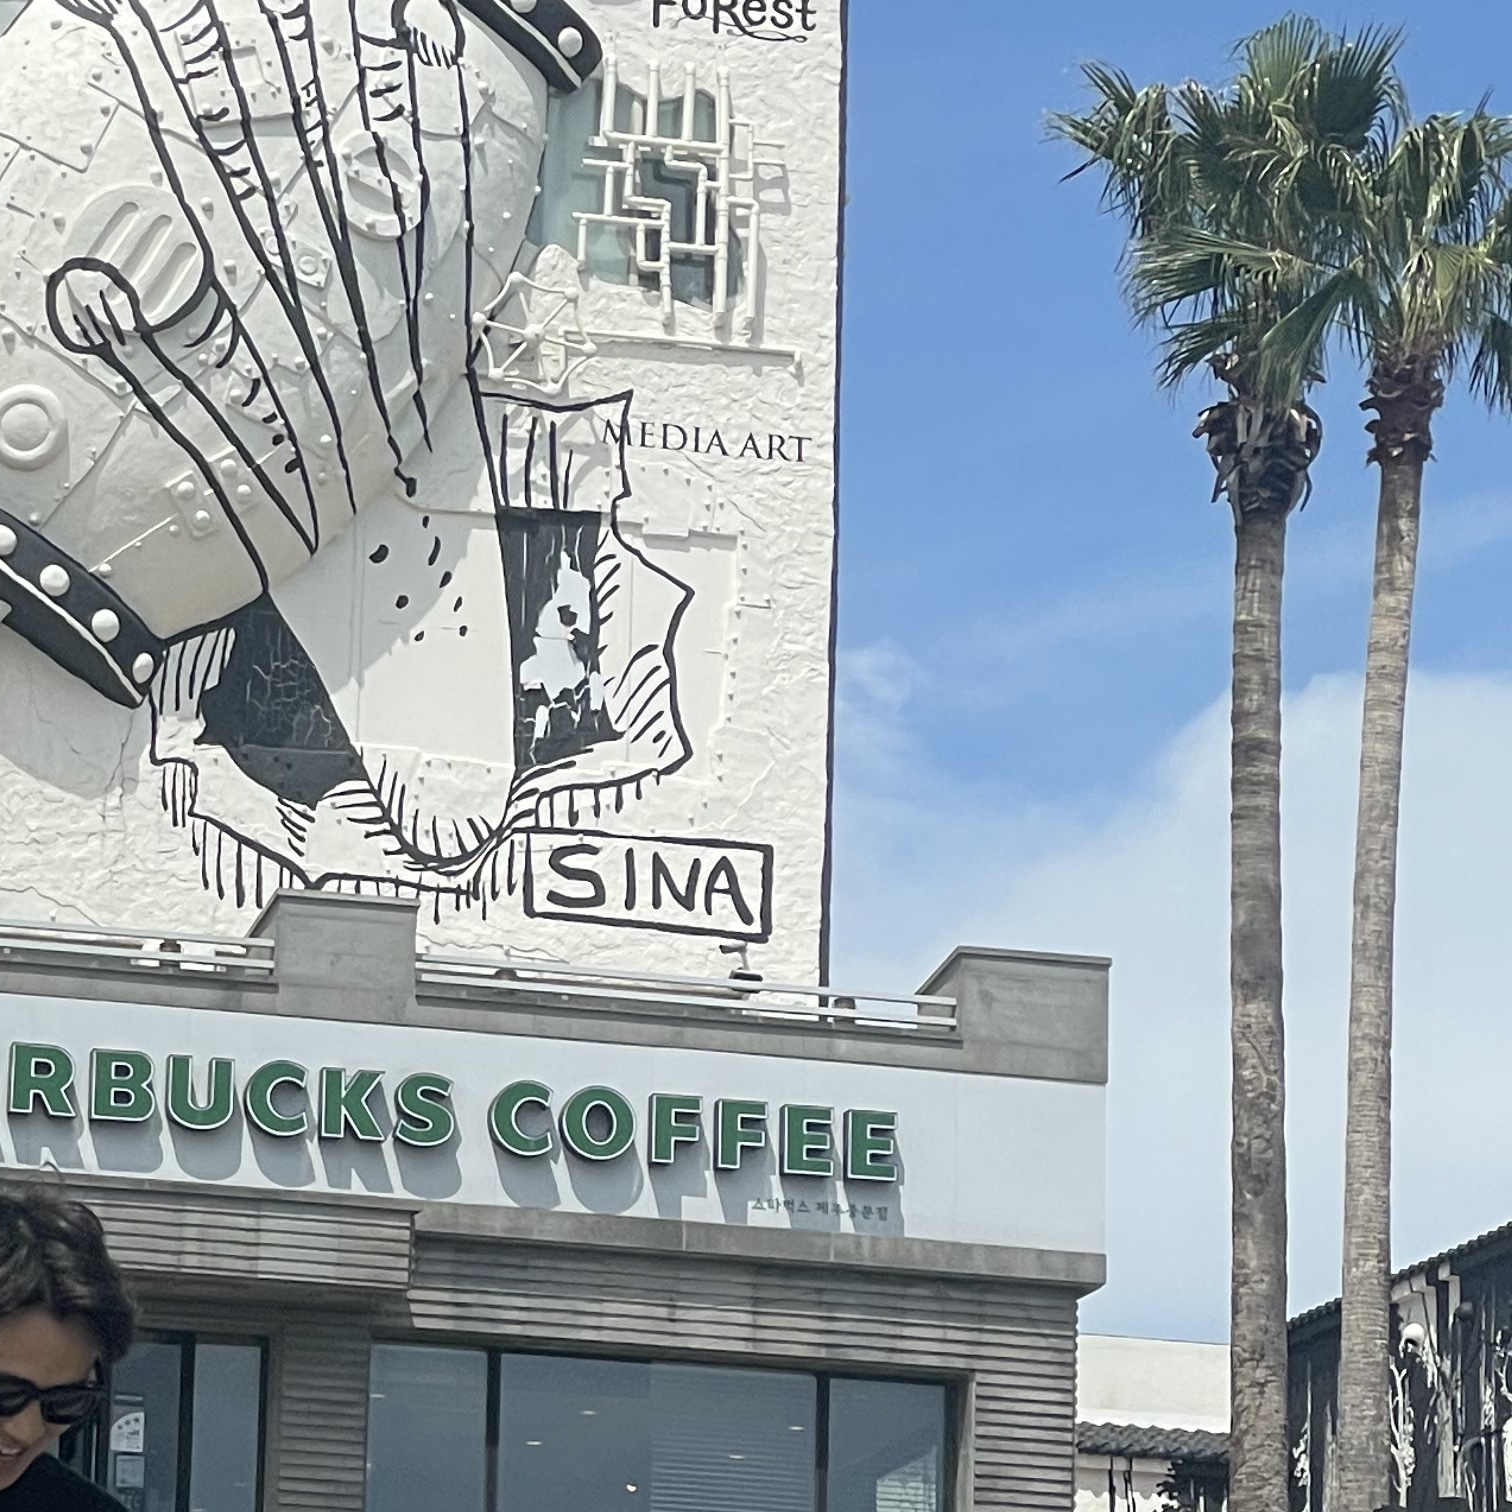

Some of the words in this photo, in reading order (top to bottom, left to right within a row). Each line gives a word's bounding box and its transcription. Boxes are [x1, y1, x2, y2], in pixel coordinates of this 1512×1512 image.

[602, 418, 729, 457] MEDIA
[739, 431, 813, 463] ART
[546, 843, 755, 927] SINA
[487, 1079, 898, 1183] COFFEE
[751, 1197, 811, 1214] 스타벅스
